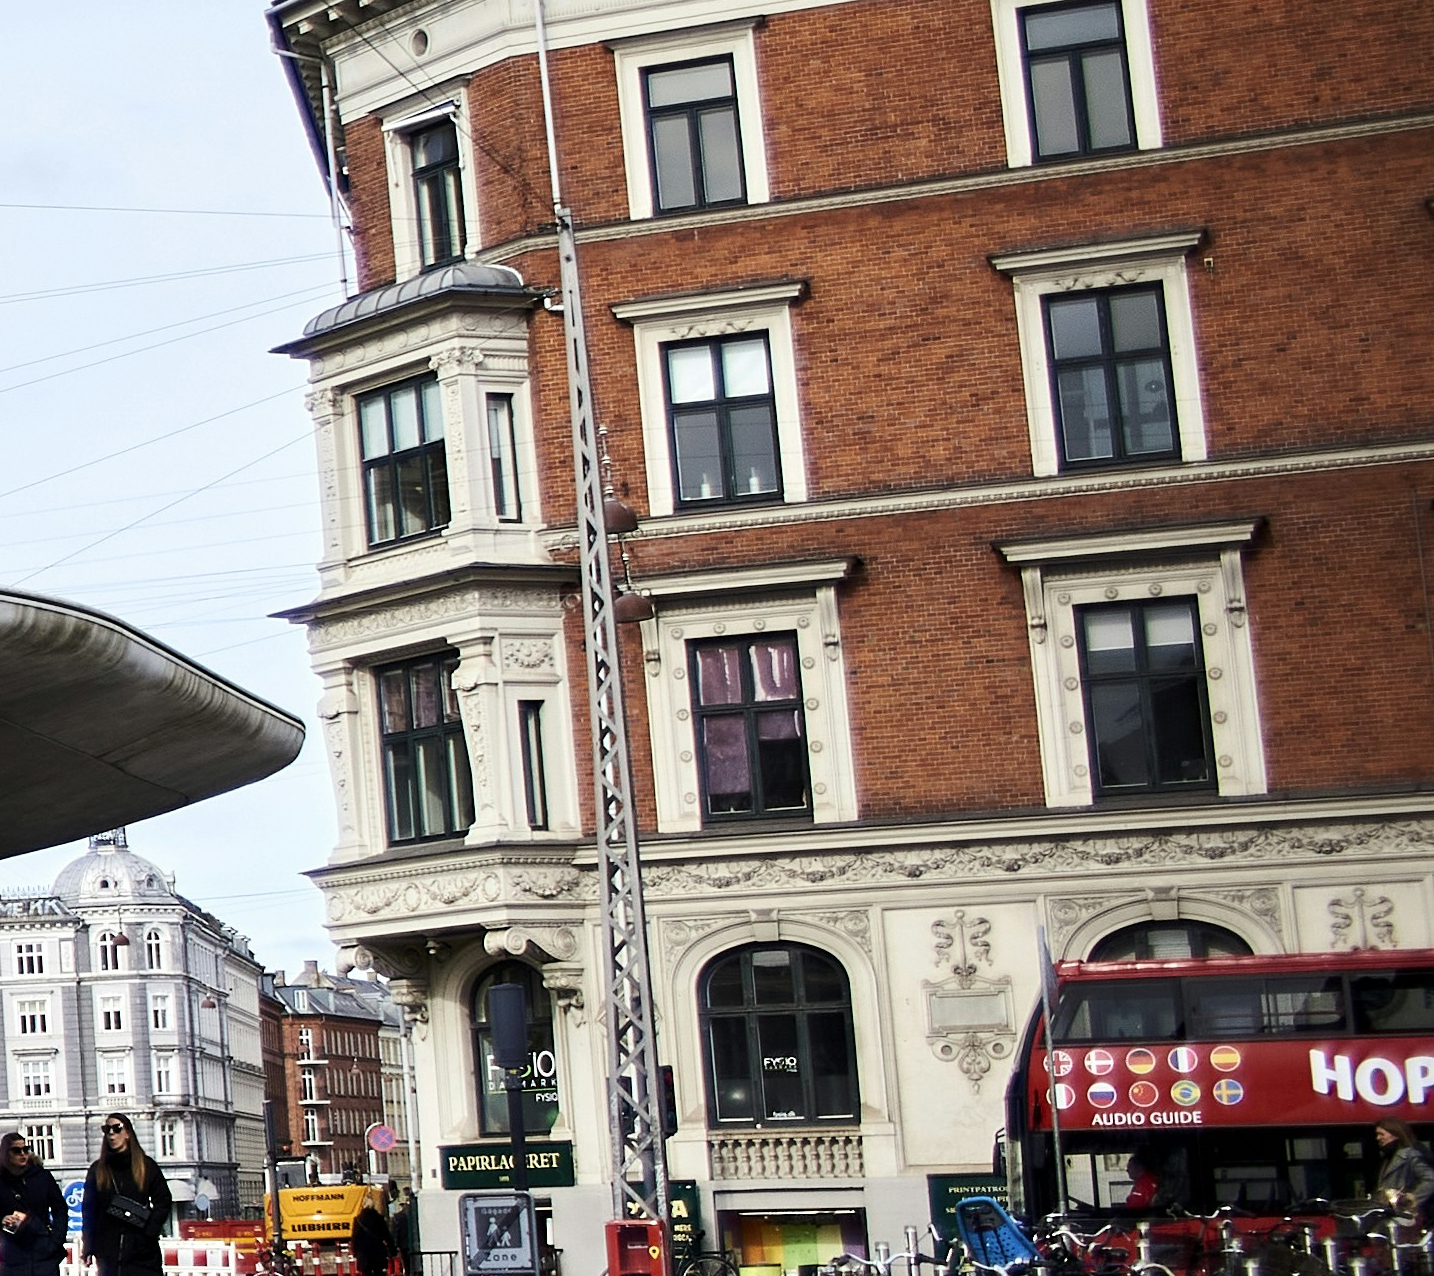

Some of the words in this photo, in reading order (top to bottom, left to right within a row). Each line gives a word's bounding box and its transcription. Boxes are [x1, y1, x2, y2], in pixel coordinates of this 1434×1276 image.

[1308, 1048, 1434, 1106] HOP
[1091, 1112, 1145, 1126] AUDIO
[1149, 1110, 1203, 1125] GUIDE
[448, 1153, 560, 1171] PAPIRLARET
[293, 1193, 345, 1202] HOFFMANN
[291, 1222, 351, 1233] LIEBHERR
